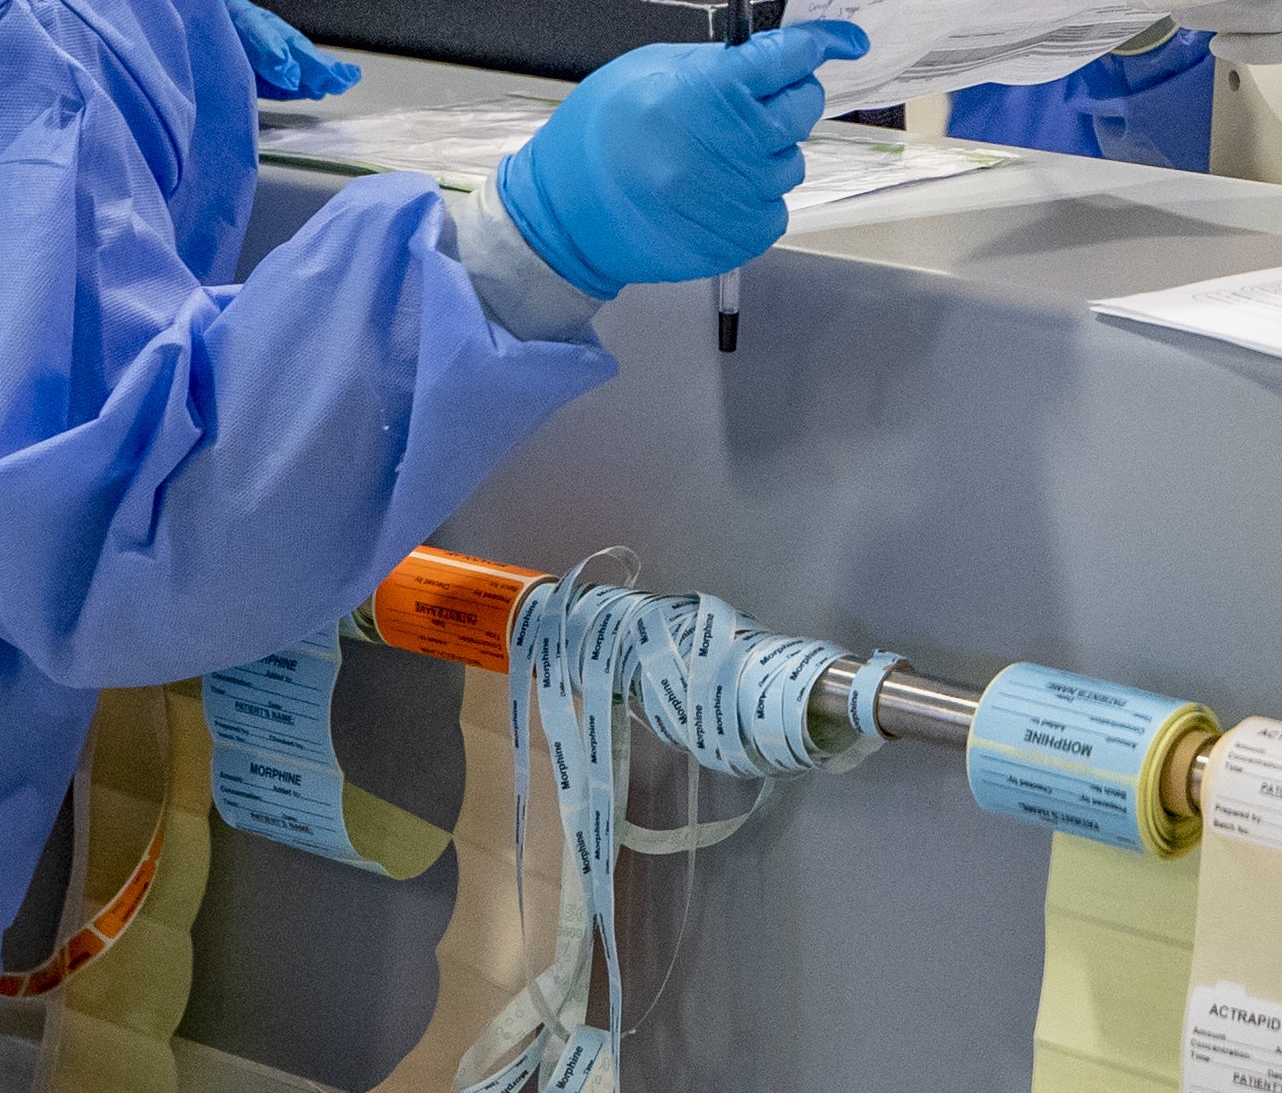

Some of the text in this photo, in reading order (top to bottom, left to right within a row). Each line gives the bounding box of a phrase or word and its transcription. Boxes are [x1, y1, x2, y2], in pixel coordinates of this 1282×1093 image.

[517, 599, 539, 647] Morphine
[591, 613, 613, 660] Morphine
[698, 613, 715, 657] Morphine
[542, 637, 552, 688] Morphine
[759, 639, 805, 666] Morphine
[789, 646, 826, 682] Morphine
[661, 678, 689, 725] Morphine
[713, 685, 725, 736] Morphine
[589, 715, 599, 765] Morphine
[695, 704, 706, 750] Morphine
[1023, 728, 1094, 758] MORPHINE
[249, 762, 302, 787] MORPHINE
[554, 741, 571, 791] Morphine
[576, 830, 593, 875] Morphine
[594, 809, 602, 861] Morphine
[1209, 1002, 1282, 1032] ACTRAPID
[555, 1045, 584, 1090] Morphine
